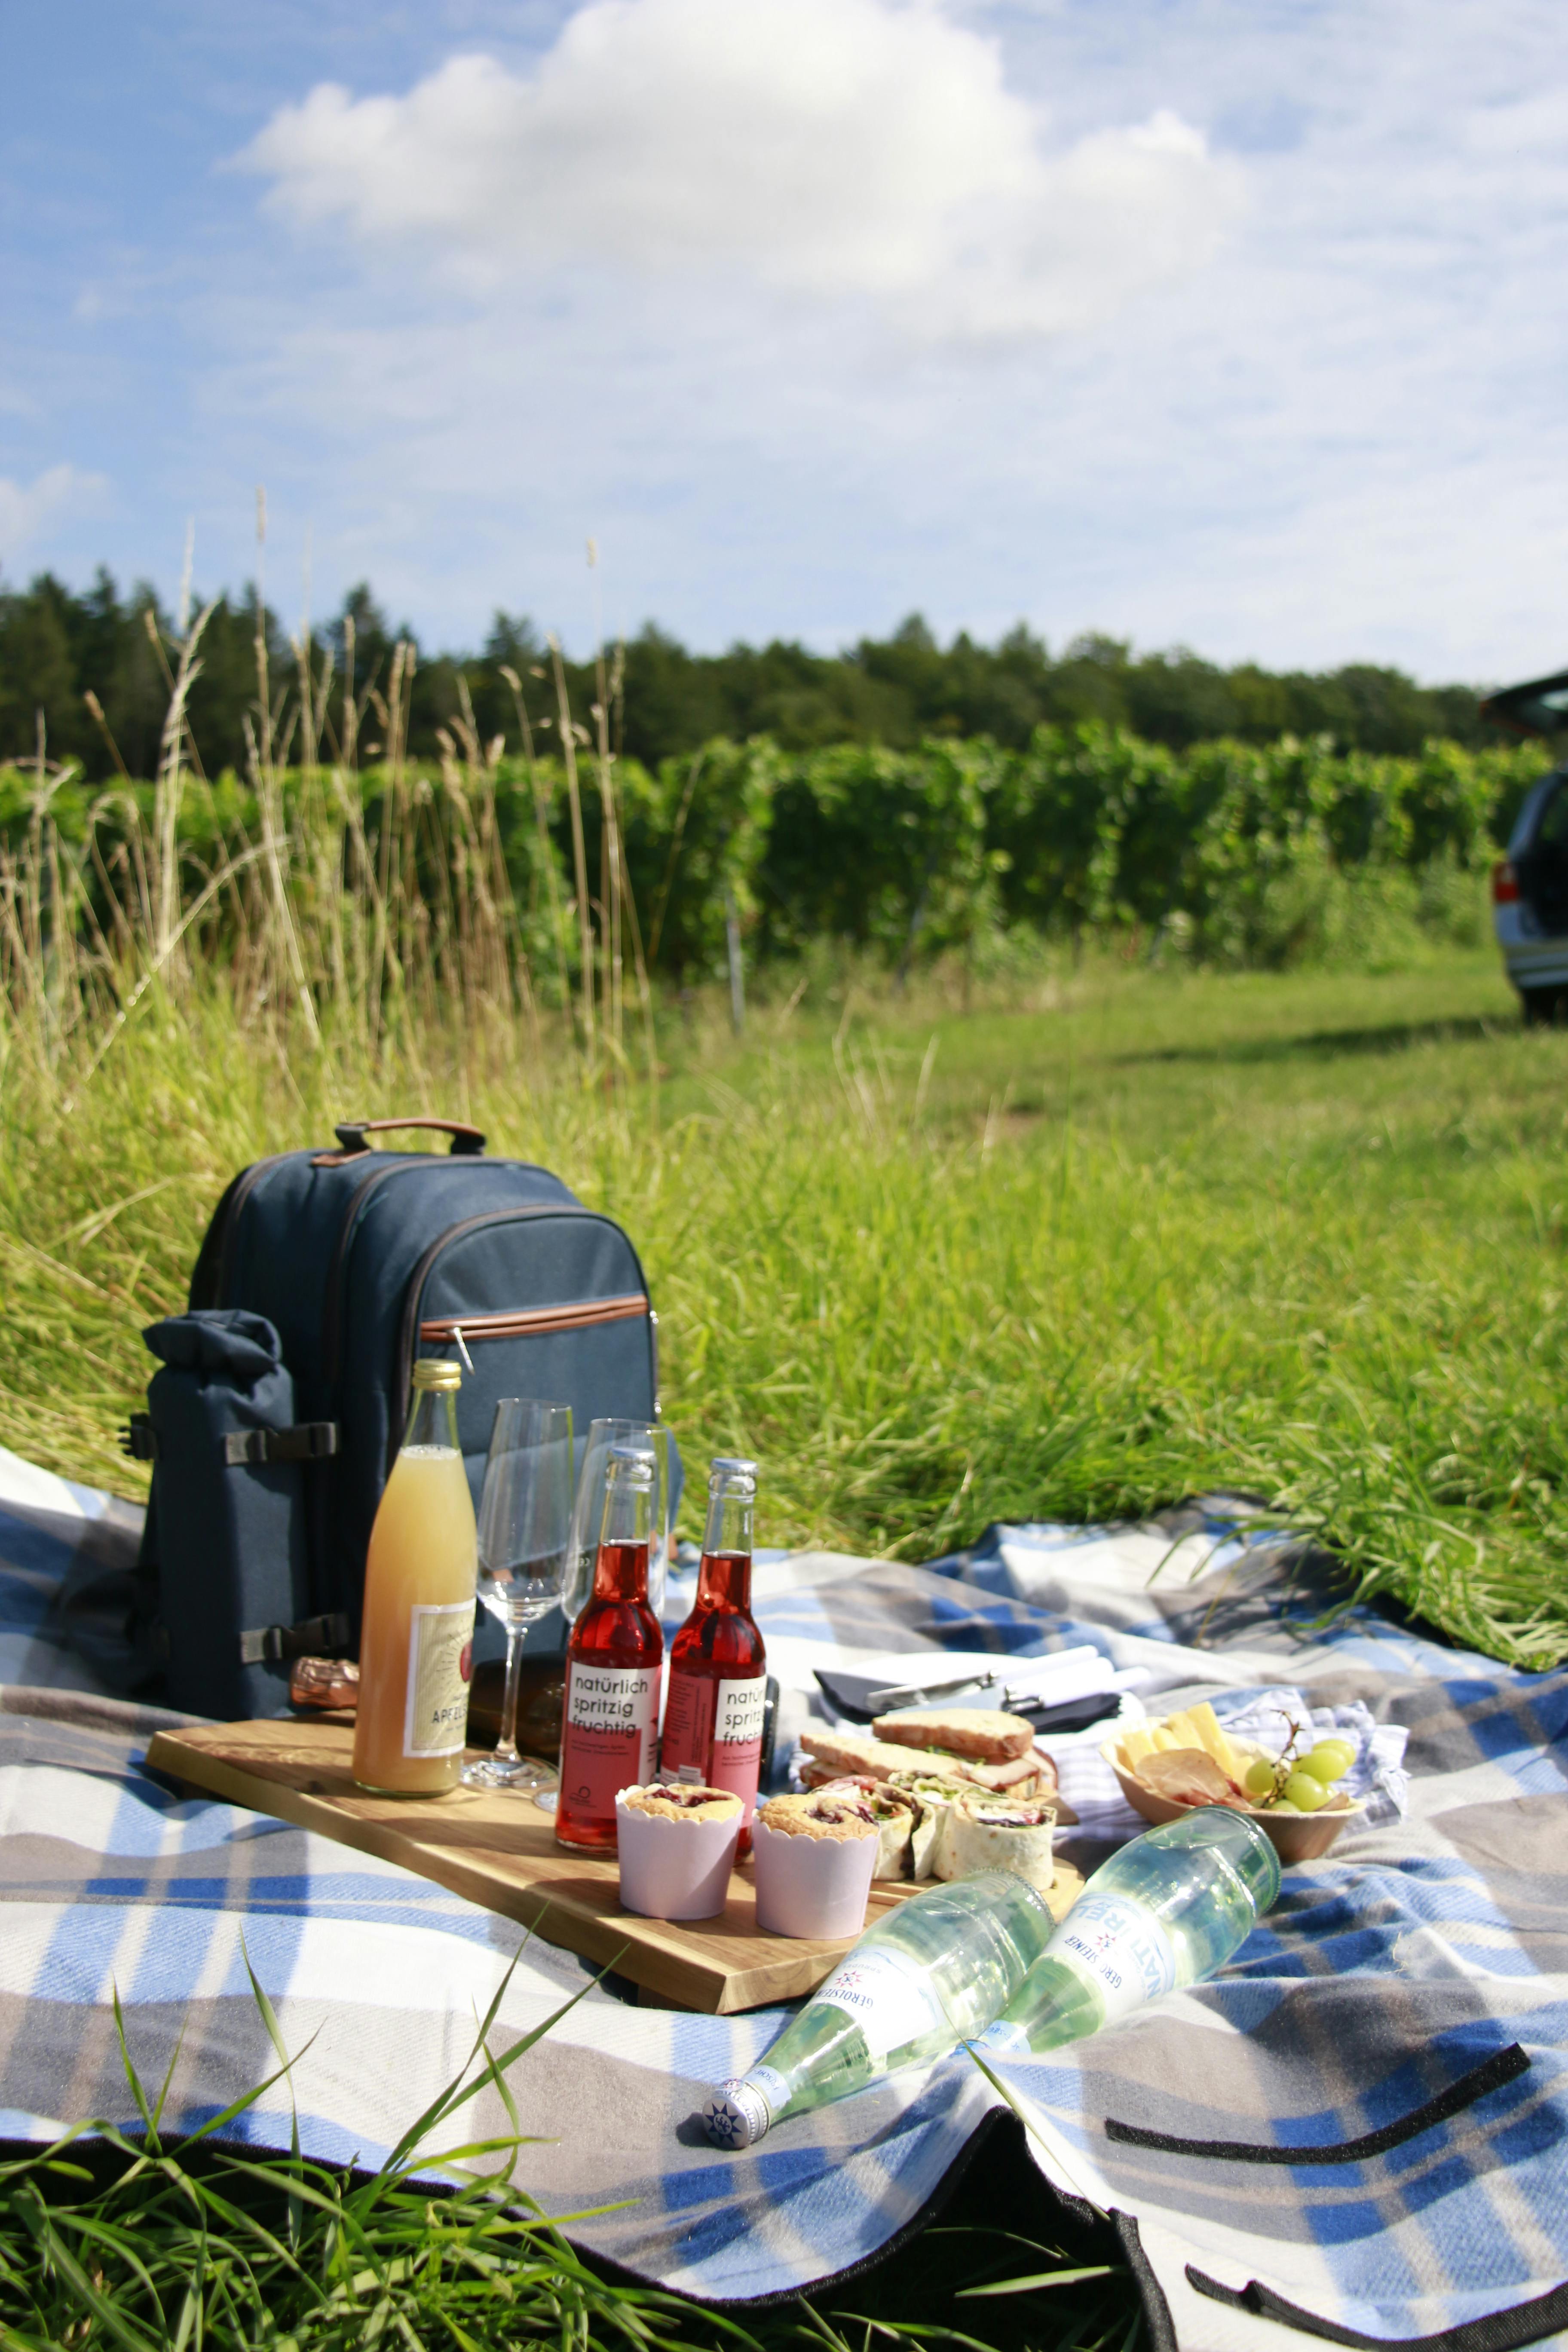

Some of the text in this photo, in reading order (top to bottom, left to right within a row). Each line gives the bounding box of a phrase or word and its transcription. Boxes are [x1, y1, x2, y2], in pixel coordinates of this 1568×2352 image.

[576, 1677, 648, 1694] natürlich
[574, 1697, 634, 1718] spritzig
[572, 1714, 636, 1739] fruchtig
